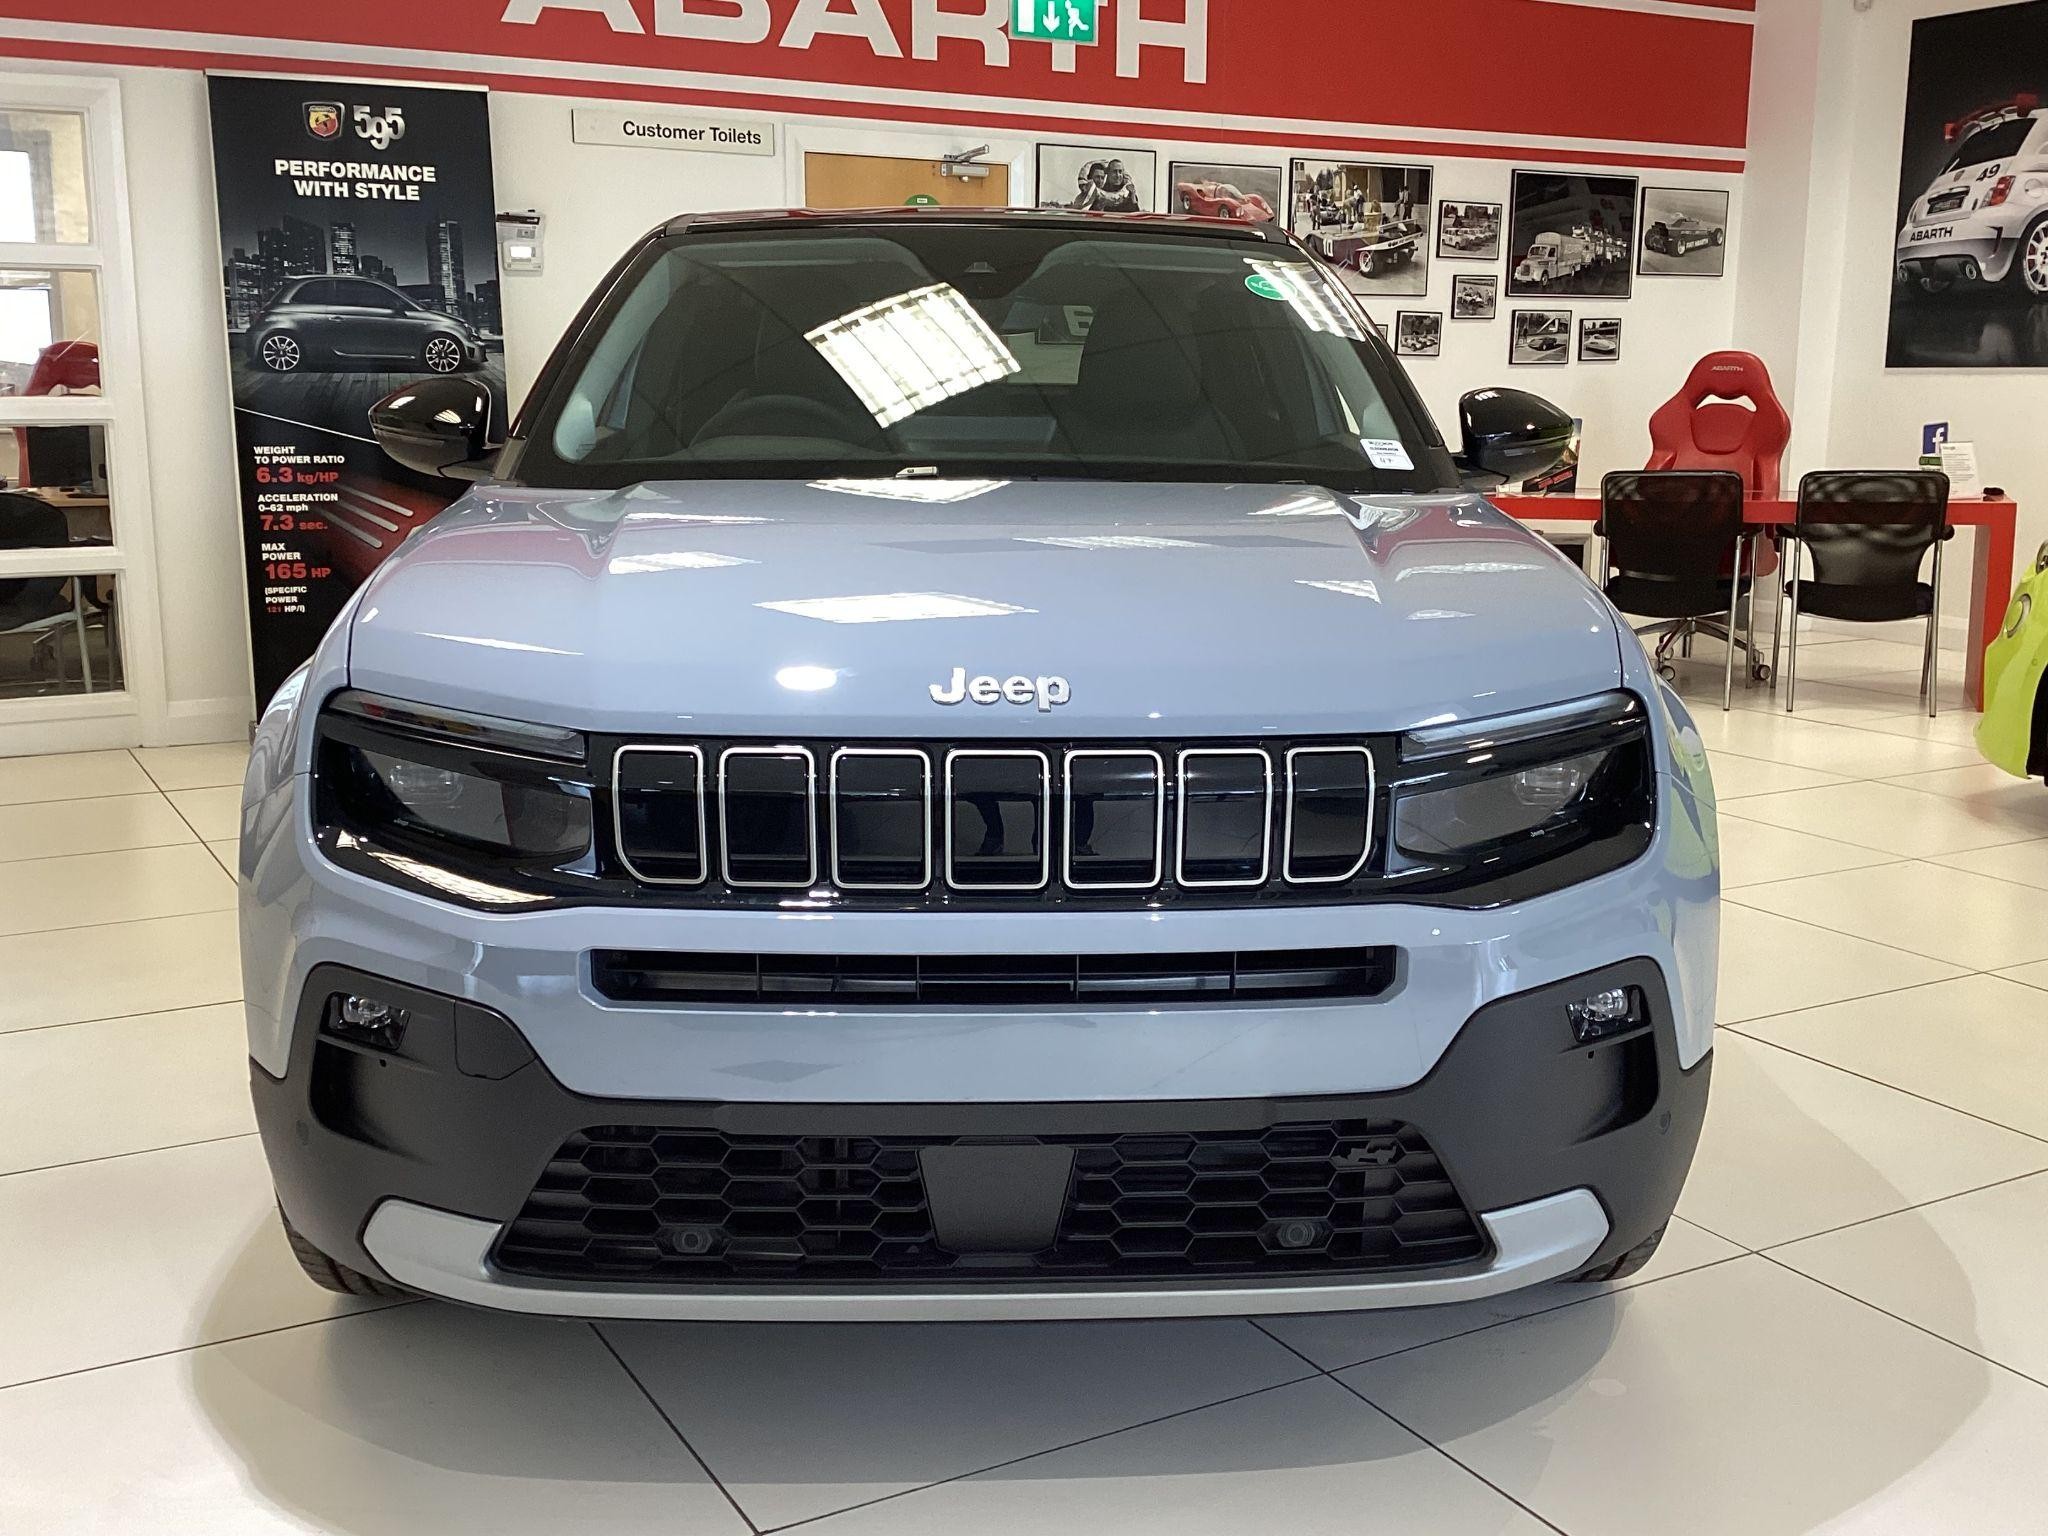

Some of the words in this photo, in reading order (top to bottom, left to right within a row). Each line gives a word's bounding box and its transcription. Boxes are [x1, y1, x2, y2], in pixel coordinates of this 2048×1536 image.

[353, 105, 406, 150] 595
[622, 120, 705, 141] Customer
[709, 126, 762, 145] Toilets
[274, 159, 437, 183] PERFORMANCE
[1975, 163, 2001, 182] 49
[293, 179, 350, 198] WITH
[354, 182, 420, 201] STYLE
[1909, 226, 1954, 243] ABARTH
[253, 445, 296, 455] WEIGHT
[254, 455, 270, 465] TO
[271, 455, 311, 465] POWER
[313, 455, 345, 464] RATIO
[256, 466, 294, 484] 6.3
[296, 471, 339, 485] kg/HP
[257, 493, 339, 503] ACCELERATION
[286, 503, 309, 513] mph
[259, 514, 295, 531] 7.3
[299, 521, 329, 531] sec.
[261, 543, 287, 552] MAX
[262, 552, 301, 561] POWER
[265, 563, 308, 580] 165
[311, 567, 332, 578] HP
[265, 596, 299, 604] POWER
[928, 666, 1072, 713] Jeep
